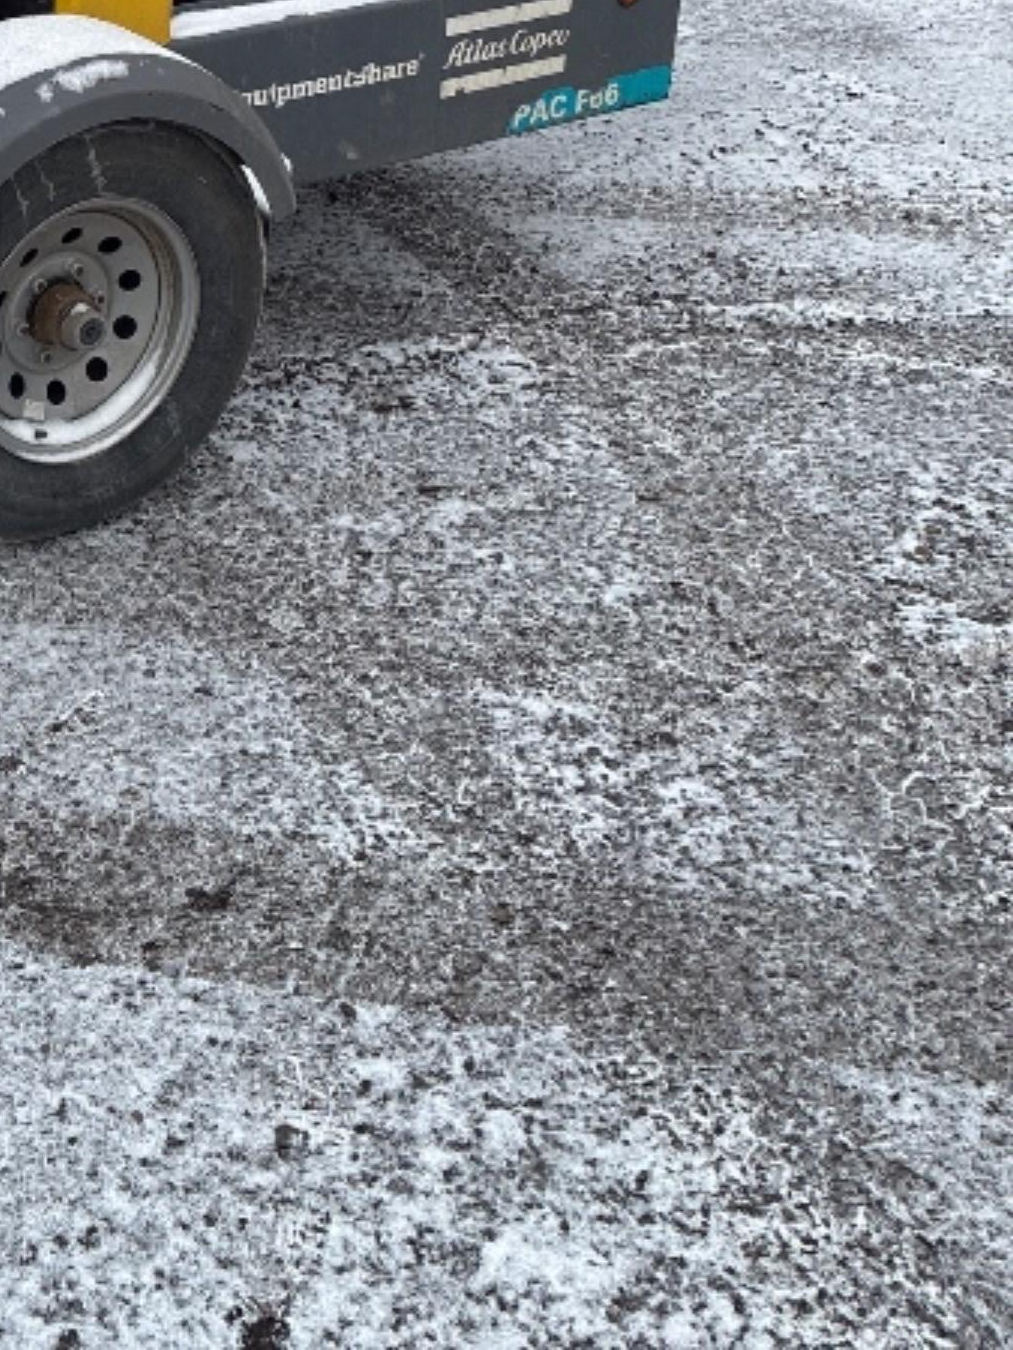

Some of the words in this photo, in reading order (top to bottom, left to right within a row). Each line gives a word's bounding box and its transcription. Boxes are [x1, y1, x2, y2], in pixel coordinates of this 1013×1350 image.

[443, 37, 506, 70] Atlas
[509, 29, 570, 58] Copco
[514, 94, 568, 128] PAC
